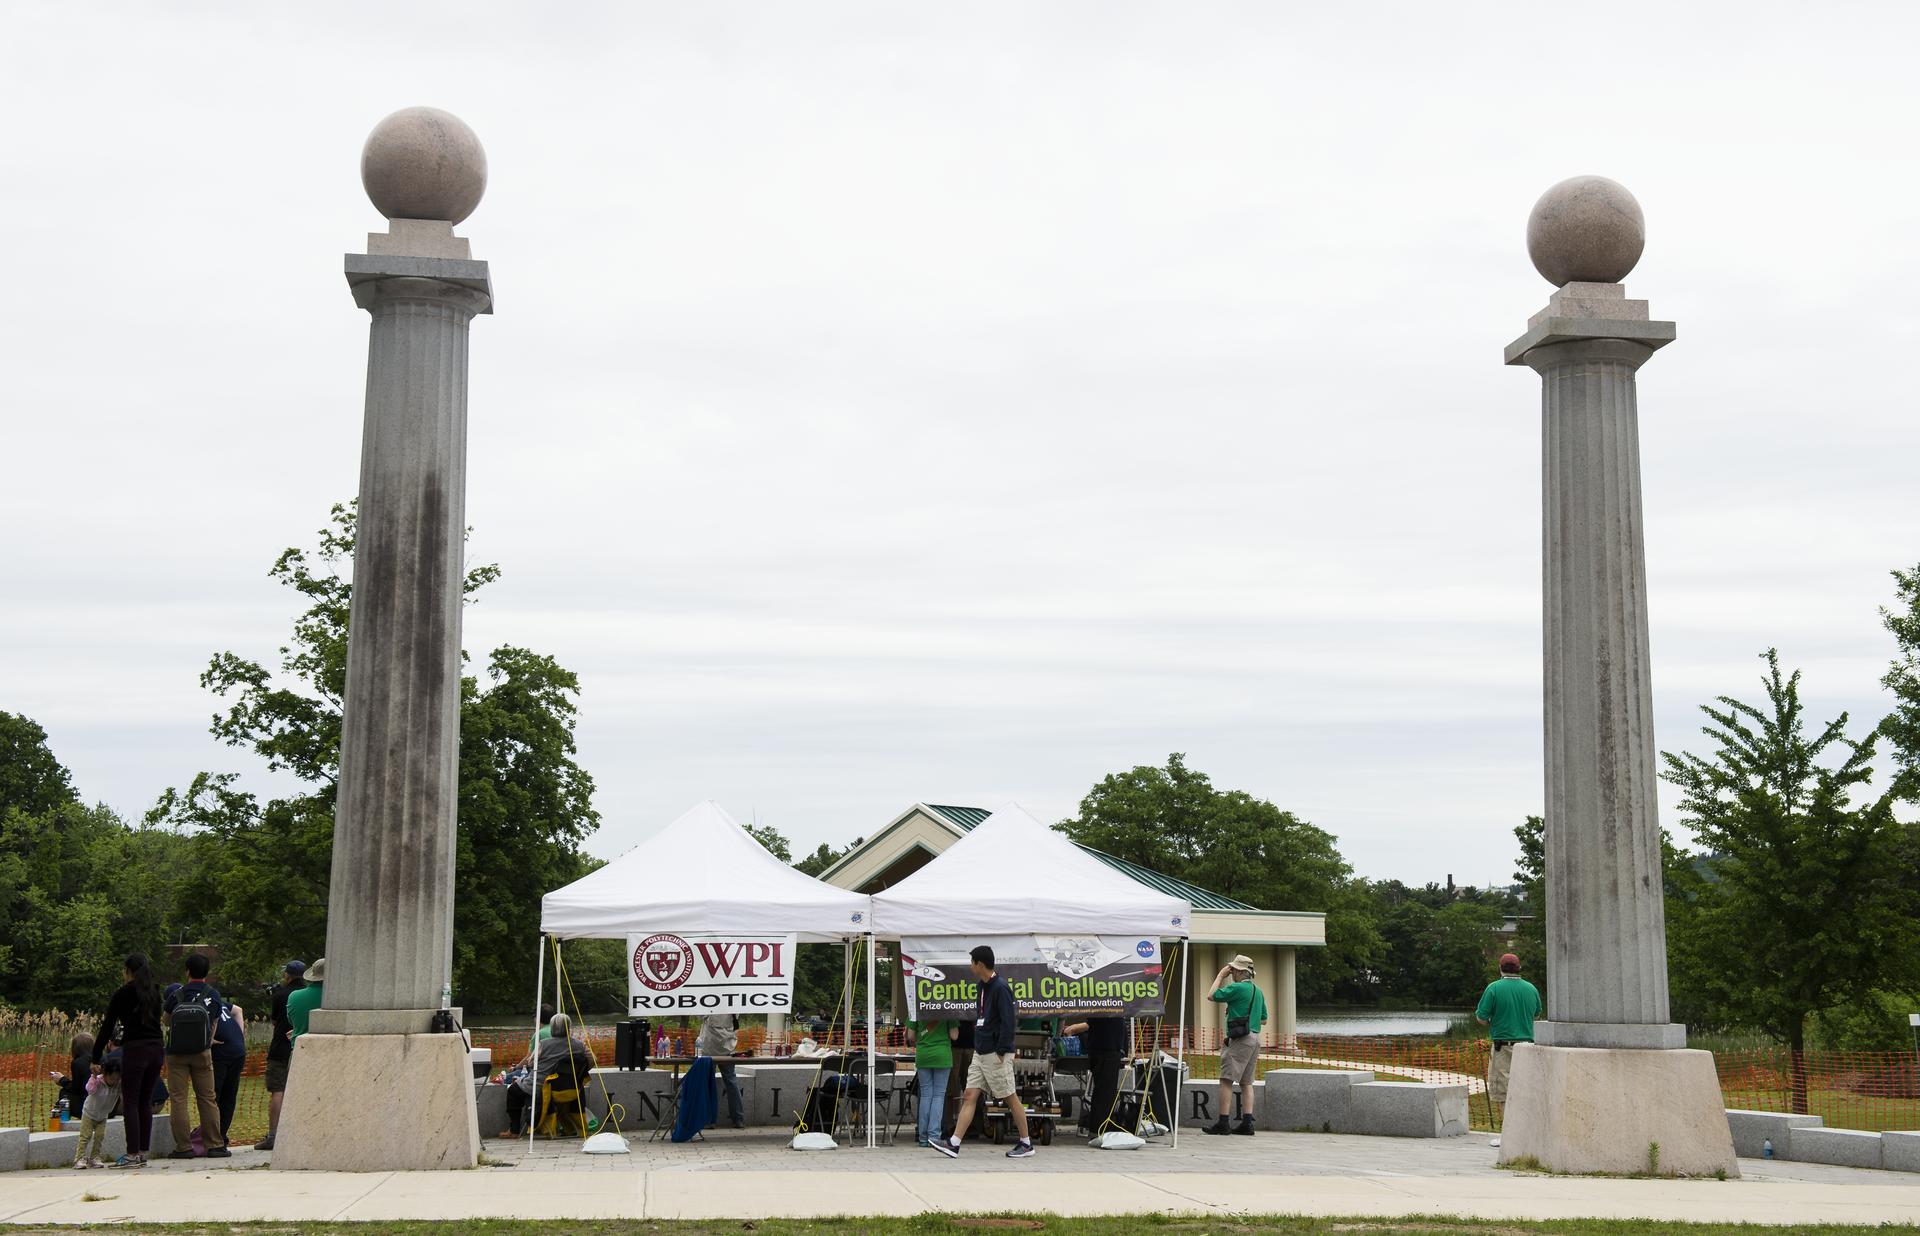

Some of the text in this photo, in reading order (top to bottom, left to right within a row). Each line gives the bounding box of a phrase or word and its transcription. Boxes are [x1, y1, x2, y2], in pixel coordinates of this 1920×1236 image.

[635, 935, 693, 983] WORCESTER POLYTECHNIC INSTITUTE
[693, 942, 785, 978] WPI
[632, 993, 789, 1009] ROBOTICS
[1040, 976, 1160, 1002] Challenges
[919, 1001, 942, 1011] Prize
[1017, 999, 1077, 1009] Technological
[1078, 998, 1123, 1007] Innovation
